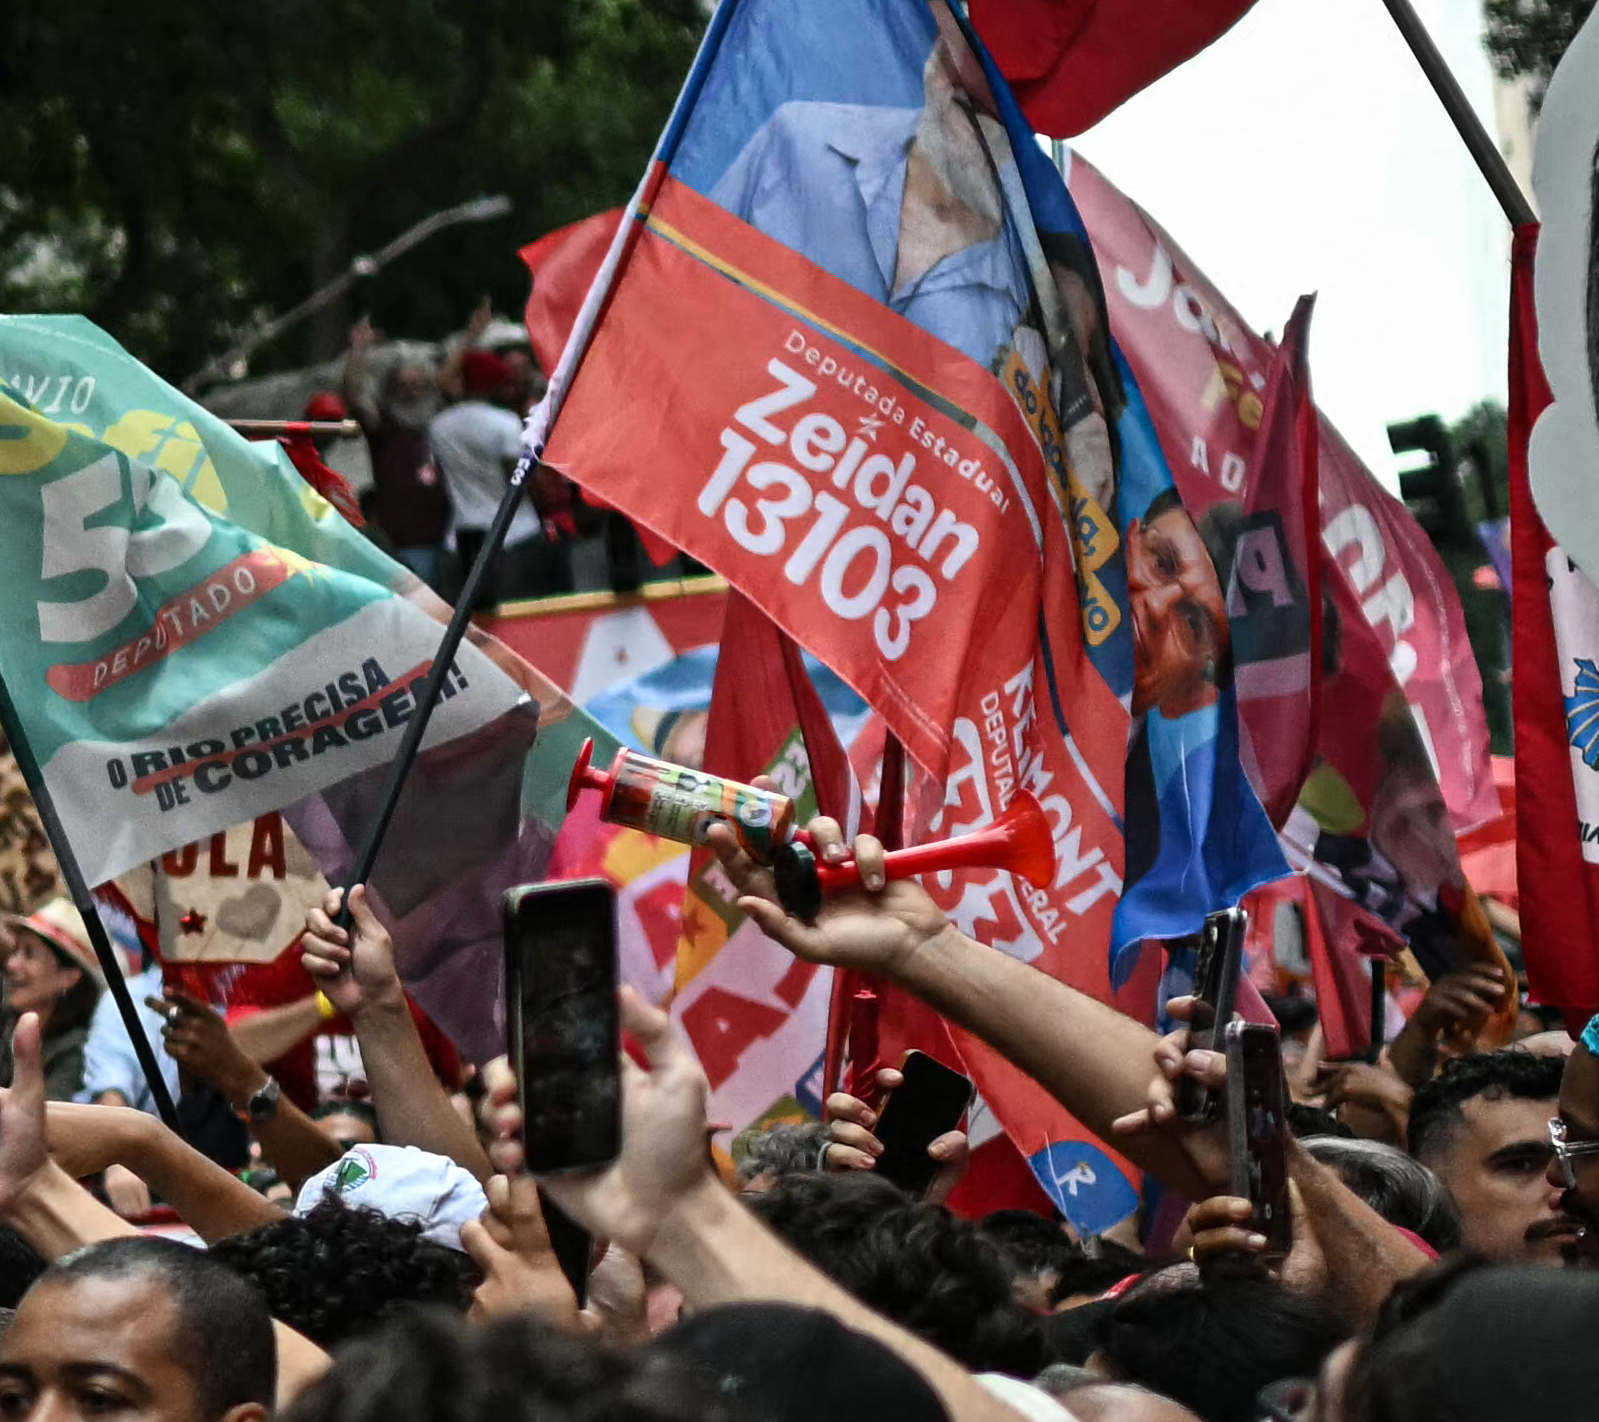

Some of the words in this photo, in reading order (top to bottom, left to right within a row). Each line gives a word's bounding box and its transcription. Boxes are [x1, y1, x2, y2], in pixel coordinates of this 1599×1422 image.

[734, 357, 980, 581] Zeidan
[784, 329, 905, 426] Deputada
[908, 417, 1011, 515] Estadual
[697, 427, 937, 661] 13103
[91, 564, 258, 688] DEPUTADO
[106, 757, 129, 790] O
[130, 739, 228, 774] RIO
[228, 657, 392, 748] PRECISA
[152, 809, 287, 881] ULA
[154, 774, 193, 812] DE
